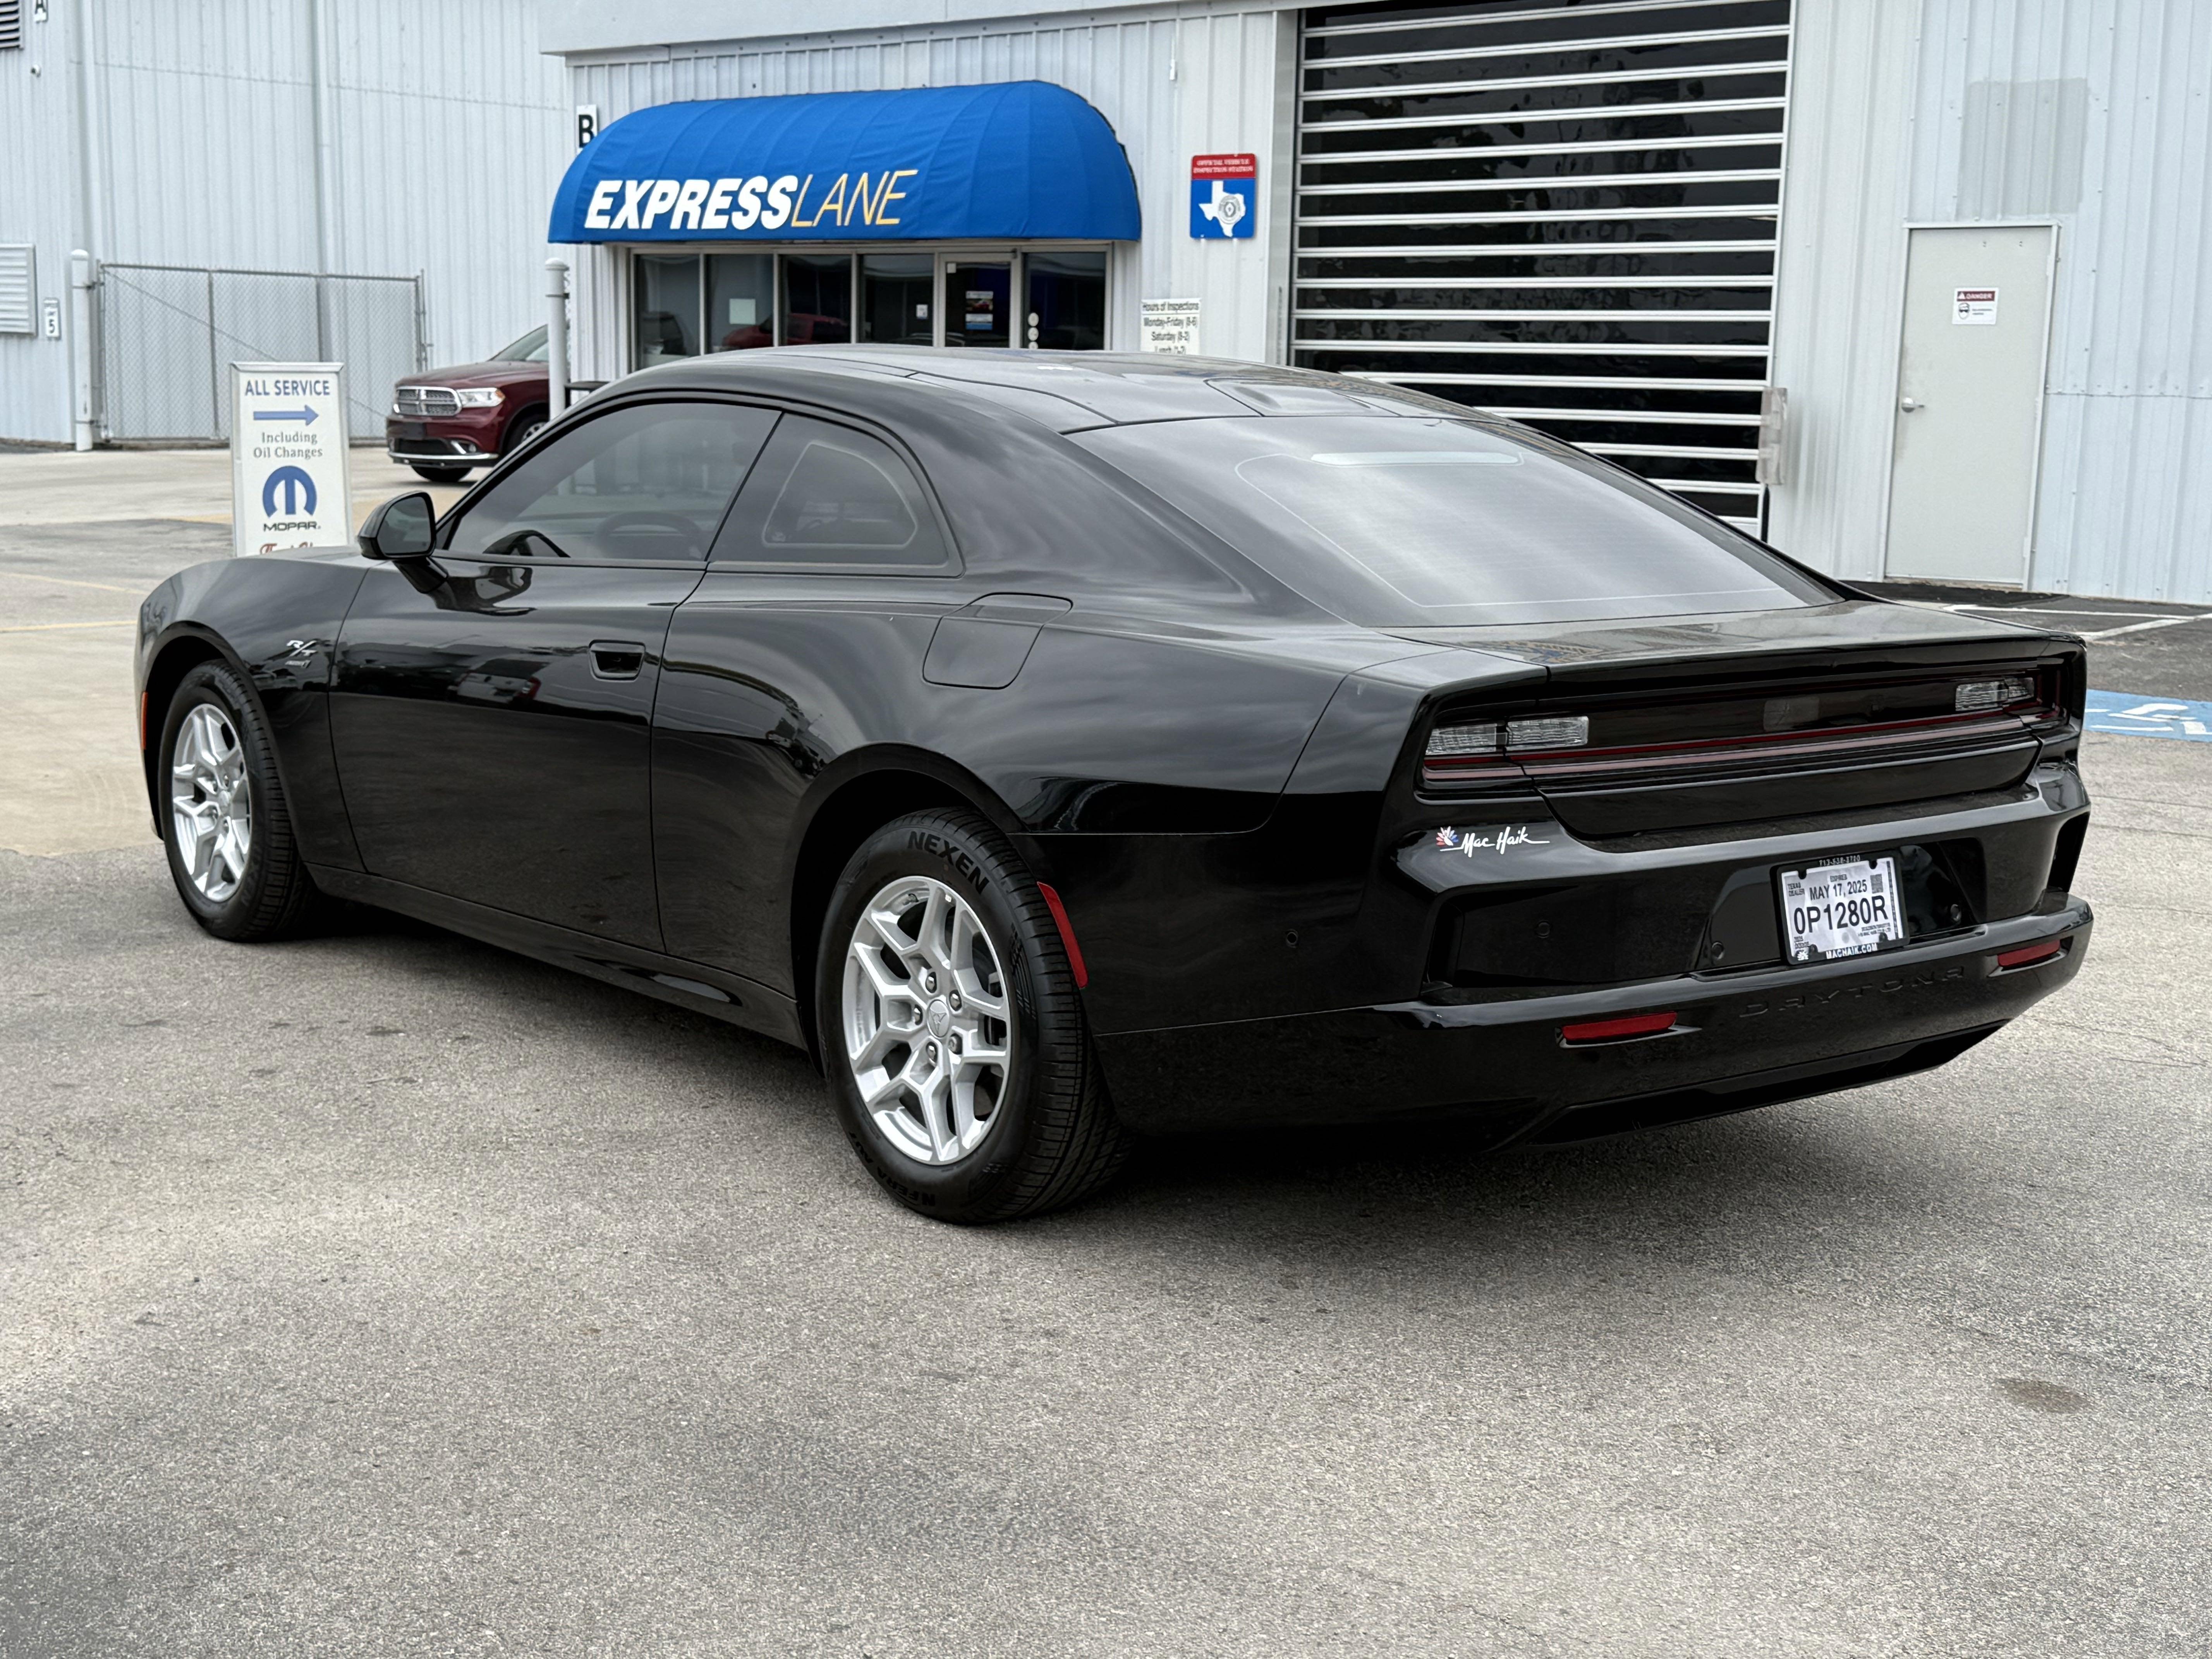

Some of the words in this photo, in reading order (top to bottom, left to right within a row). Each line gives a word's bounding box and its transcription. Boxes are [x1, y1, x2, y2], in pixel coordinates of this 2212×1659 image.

[579, 114, 594, 148] B
[48, 319, 55, 334] 5
[1151, 331, 1176, 343] Saturday
[245, 380, 270, 396] ALL
[274, 380, 330, 396] SERVICE
[261, 431, 317, 444] Including
[253, 447, 271, 458] Oil
[274, 447, 323, 460] Changes
[263, 521, 318, 532] MOPAR
[1440, 833, 1495, 857] Mac
[1496, 826, 1550, 854] Haik
[907, 831, 989, 894] NEXEN
[1809, 885, 1830, 900] MAY
[1833, 883, 1846, 898] 17,
[1847, 879, 1867, 895] 2025
[1794, 895, 1889, 934] 0P1280R
[1826, 942, 1878, 959] MACHAIK.COM
[1739, 965, 1965, 1018] DAYTONA
